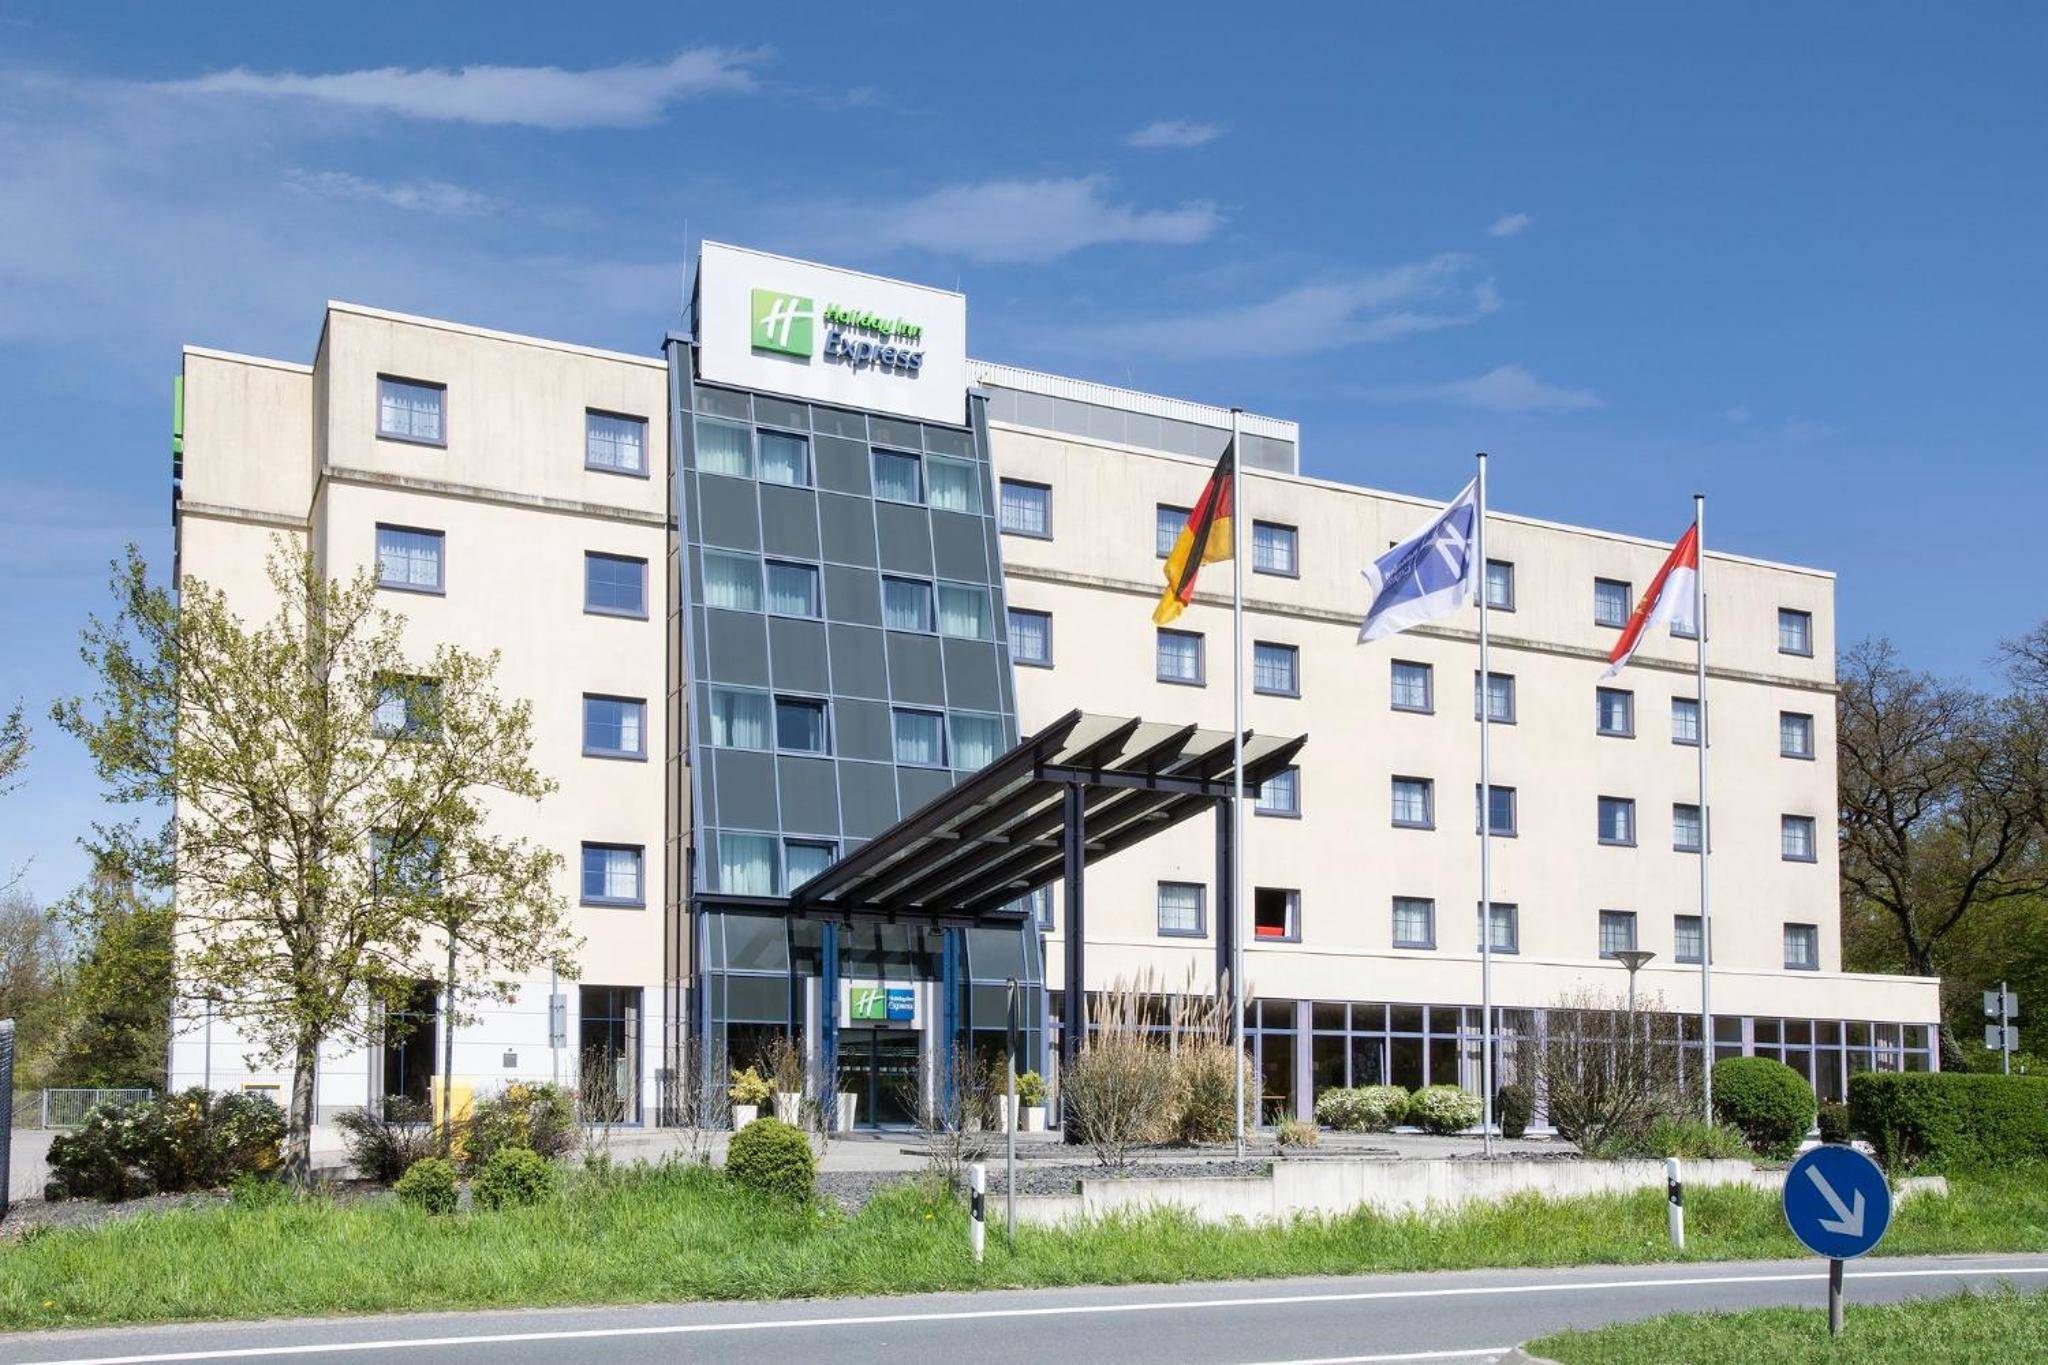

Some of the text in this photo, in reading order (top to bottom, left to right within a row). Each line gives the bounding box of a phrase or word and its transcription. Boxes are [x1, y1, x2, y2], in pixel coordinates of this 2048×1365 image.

[823, 303, 923, 341] Holiday Inn
[823, 330, 925, 371] Express
